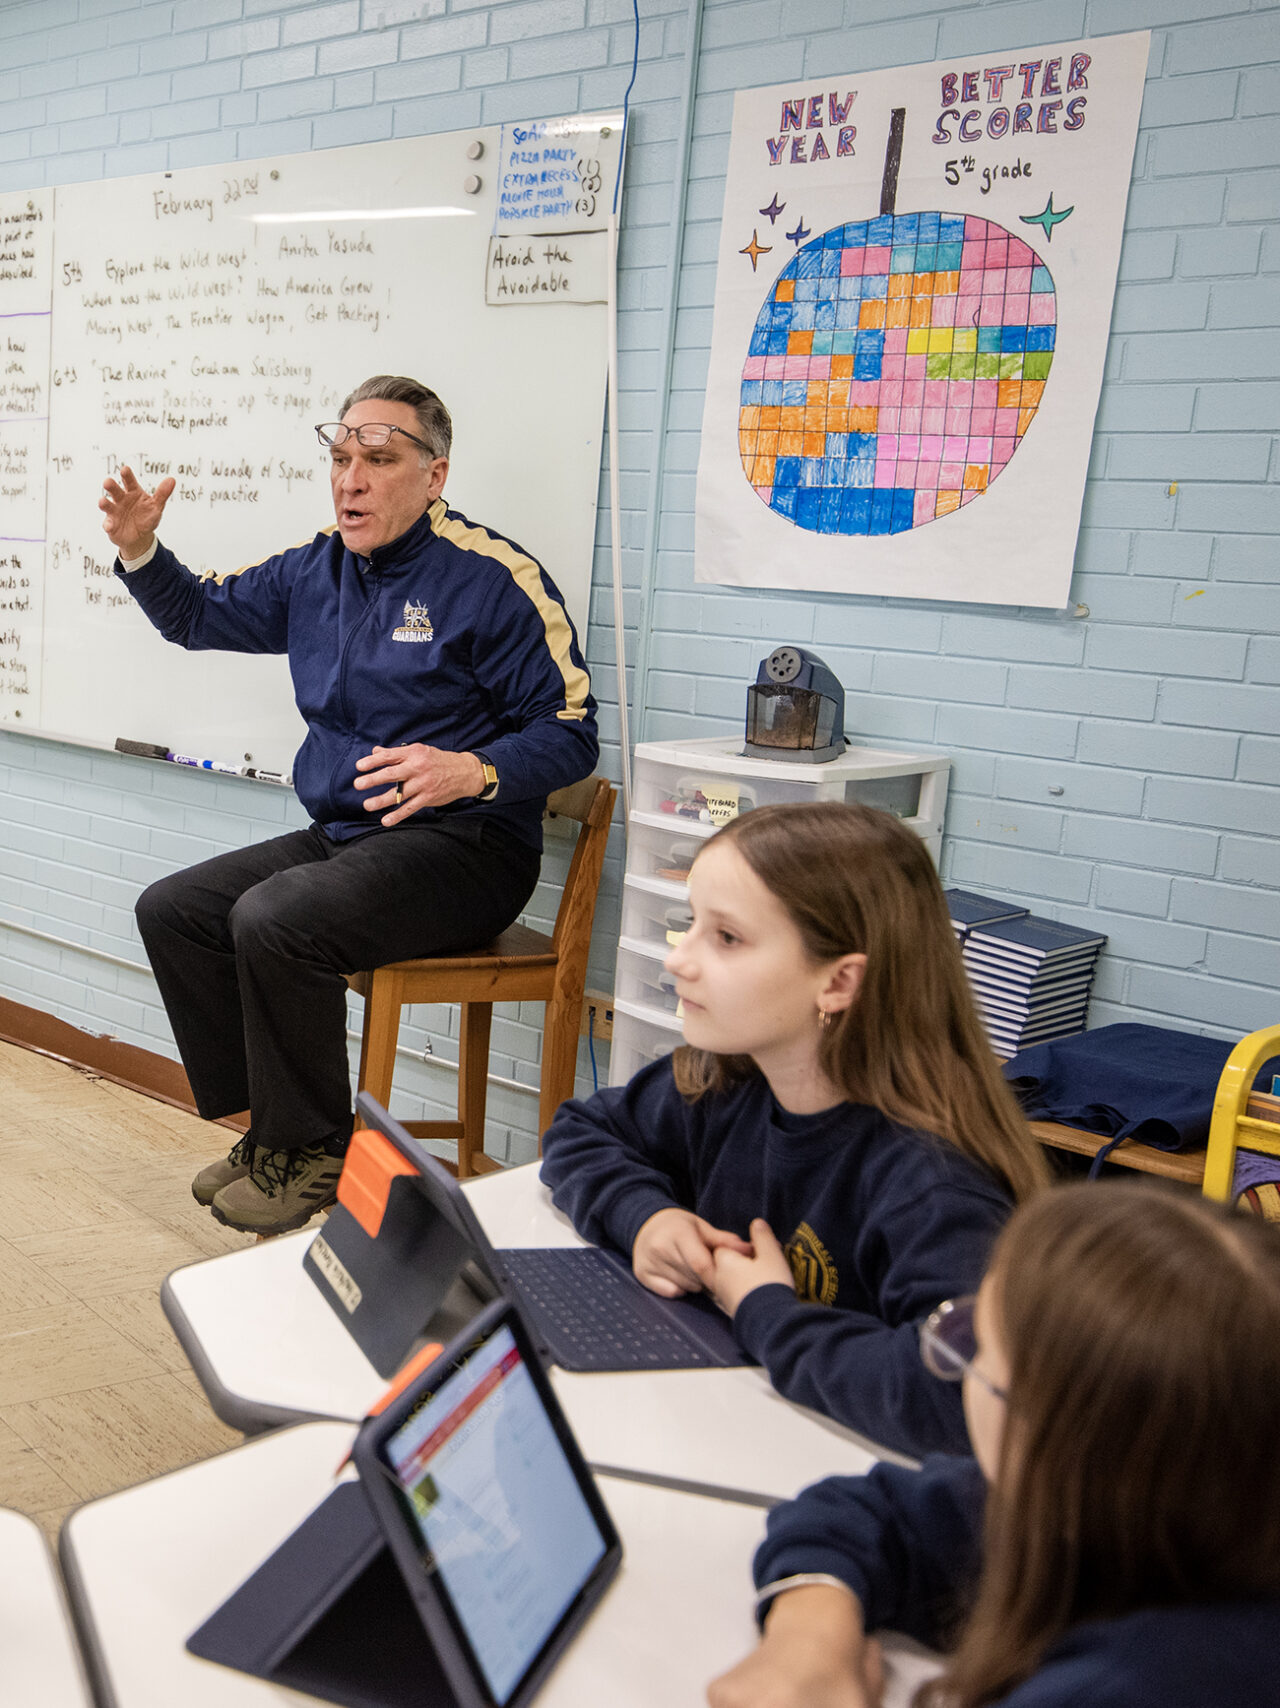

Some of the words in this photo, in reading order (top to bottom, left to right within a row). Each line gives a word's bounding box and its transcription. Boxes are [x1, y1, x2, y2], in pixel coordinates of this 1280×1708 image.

[941, 52, 1092, 107] BETTER
[780, 91, 858, 132] NEW
[932, 97, 1087, 144] SCORES
[544, 148, 576, 162] PARTY
[766, 126, 857, 165] YEAR
[503, 173, 538, 189] EXTRA
[541, 168, 579, 184] RECESS
[945, 156, 975, 186] 5th
[980, 157, 1032, 194] grade
[152, 189, 215, 222] February
[223, 172, 261, 204] 22nd
[542, 201, 572, 215] PARTY
[575, 195, 596, 217] (3)
[278, 234, 320, 259] Anita
[327, 229, 375, 255] Yasuda
[493, 244, 534, 269] Avoid
[543, 244, 573, 265] the
[63, 262, 83, 286] 5th
[105, 259, 146, 283] Explore
[153, 254, 171, 273] the
[180, 251, 209, 270] Wild
[120, 292, 141, 306] was
[147, 286, 162, 303] the
[257, 278, 279, 299] How
[285, 277, 334, 297] America
[497, 271, 570, 297] Avoidable
[86, 320, 122, 341] Moving
[190, 305, 233, 328] Frontier
[305, 303, 328, 322] Get
[8, 336, 26, 353] how
[190, 355, 240, 378] Graham
[251, 356, 313, 385] Salisbury
[284, 394, 312, 417] page
[189, 411, 229, 434] practice
[139, 453, 171, 477] Terror
[178, 456, 200, 477] and
[211, 457, 252, 479] Wonder
[261, 459, 273, 478] of
[179, 484, 204, 502] test
[210, 488, 259, 508] practice
[11, 554, 22, 569] the
[85, 586, 102, 604] Test
[392, 631, 434, 643] GUARDIANS
